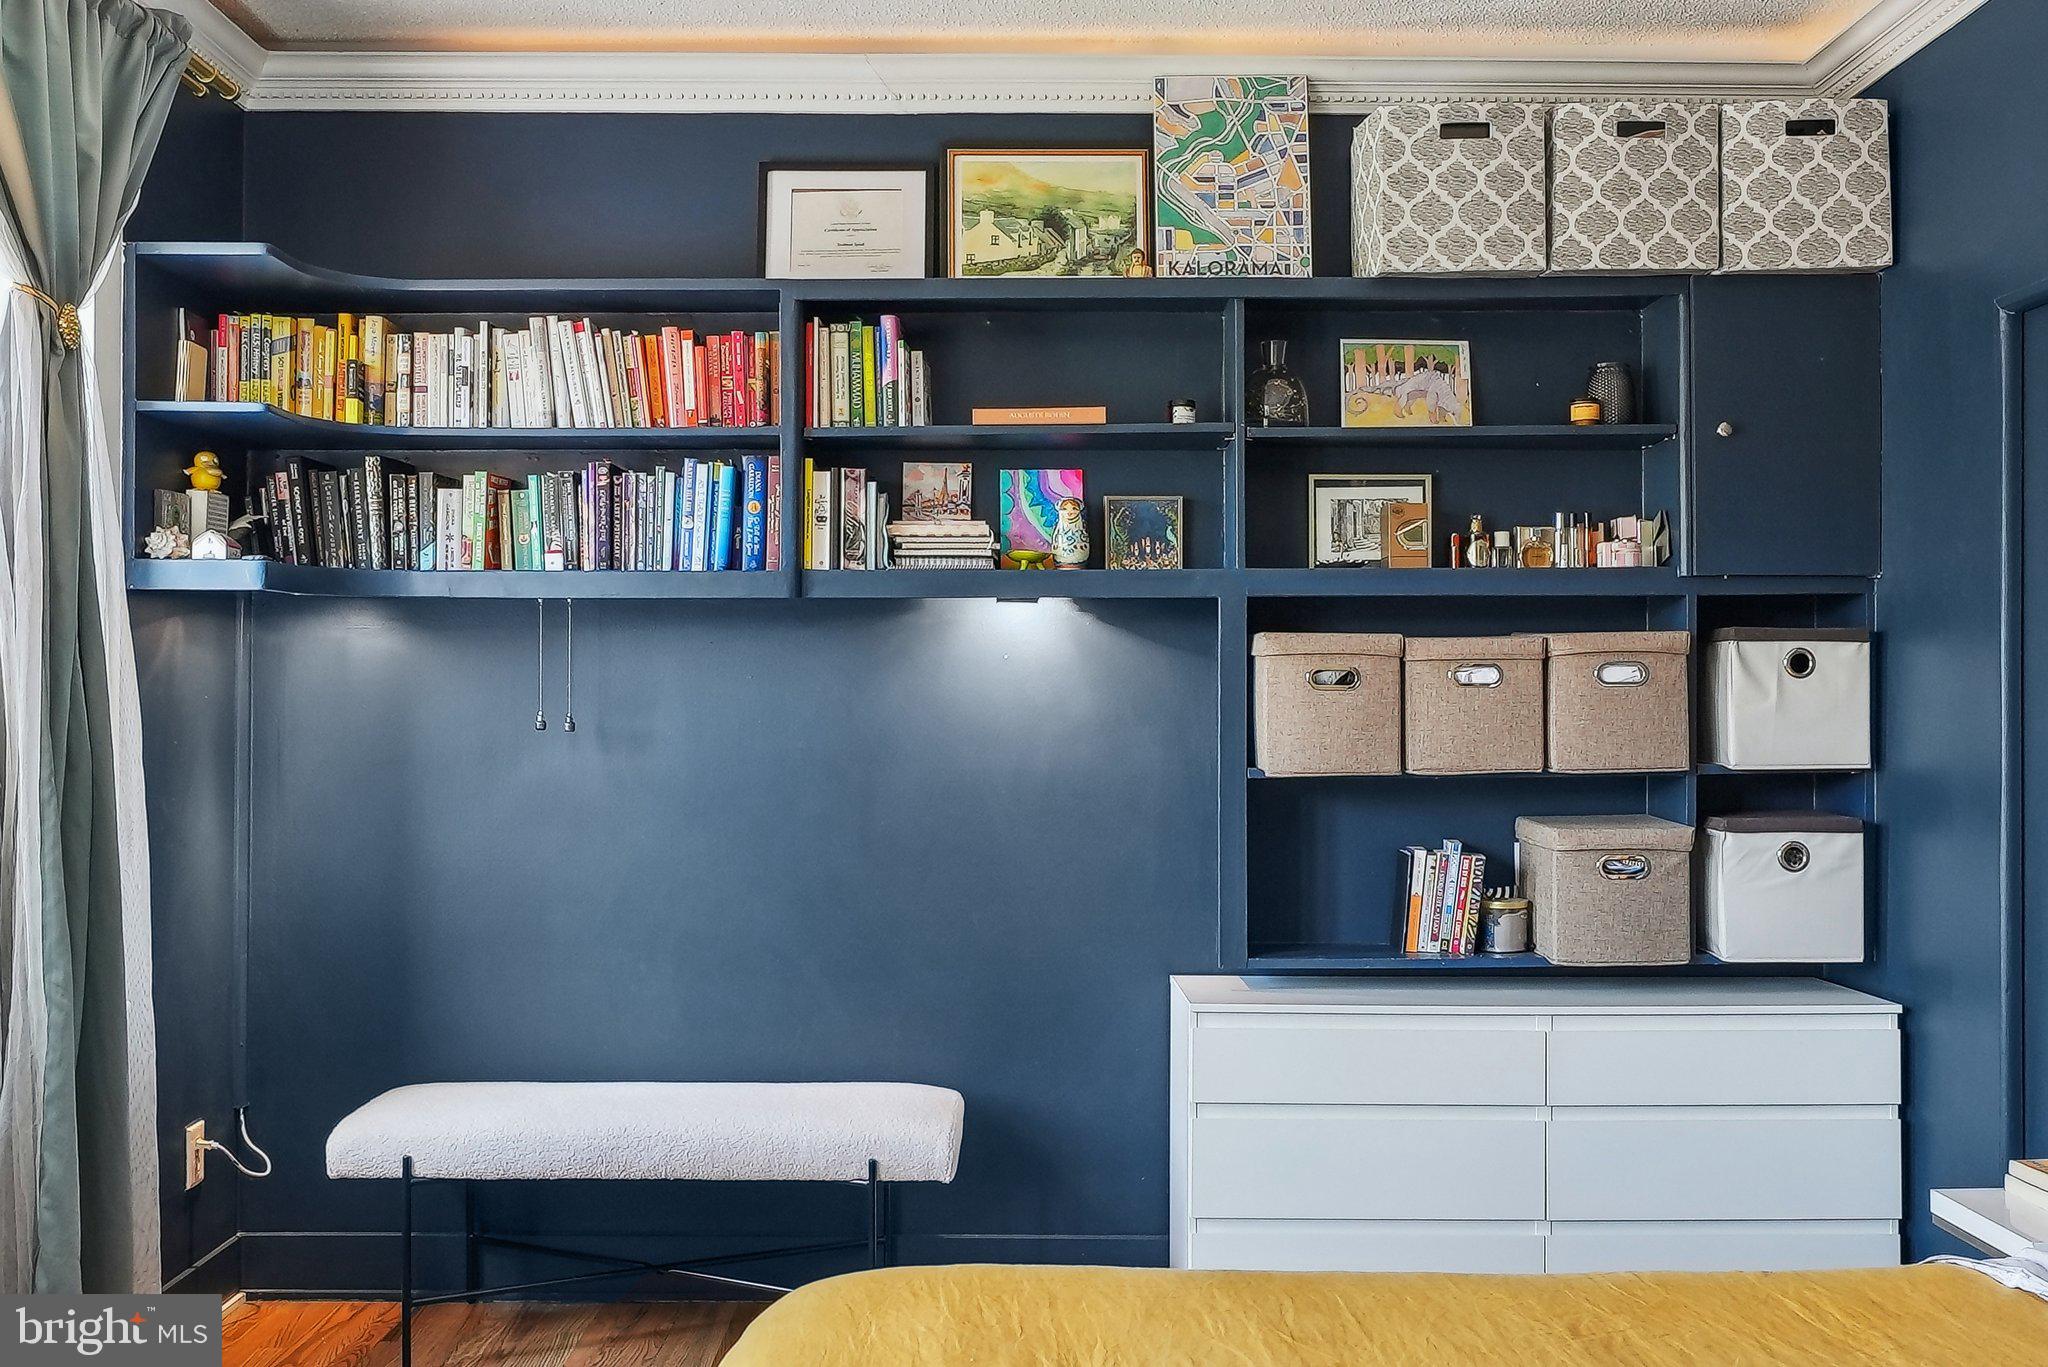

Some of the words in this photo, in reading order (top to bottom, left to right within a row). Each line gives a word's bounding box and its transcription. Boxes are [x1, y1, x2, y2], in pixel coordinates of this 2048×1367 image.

[1168, 261, 1281, 275] KALORAMA
[262, 338, 271, 371] Congress
[852, 352, 861, 408] MUHAMMAD
[354, 505, 363, 539] SERPENT
